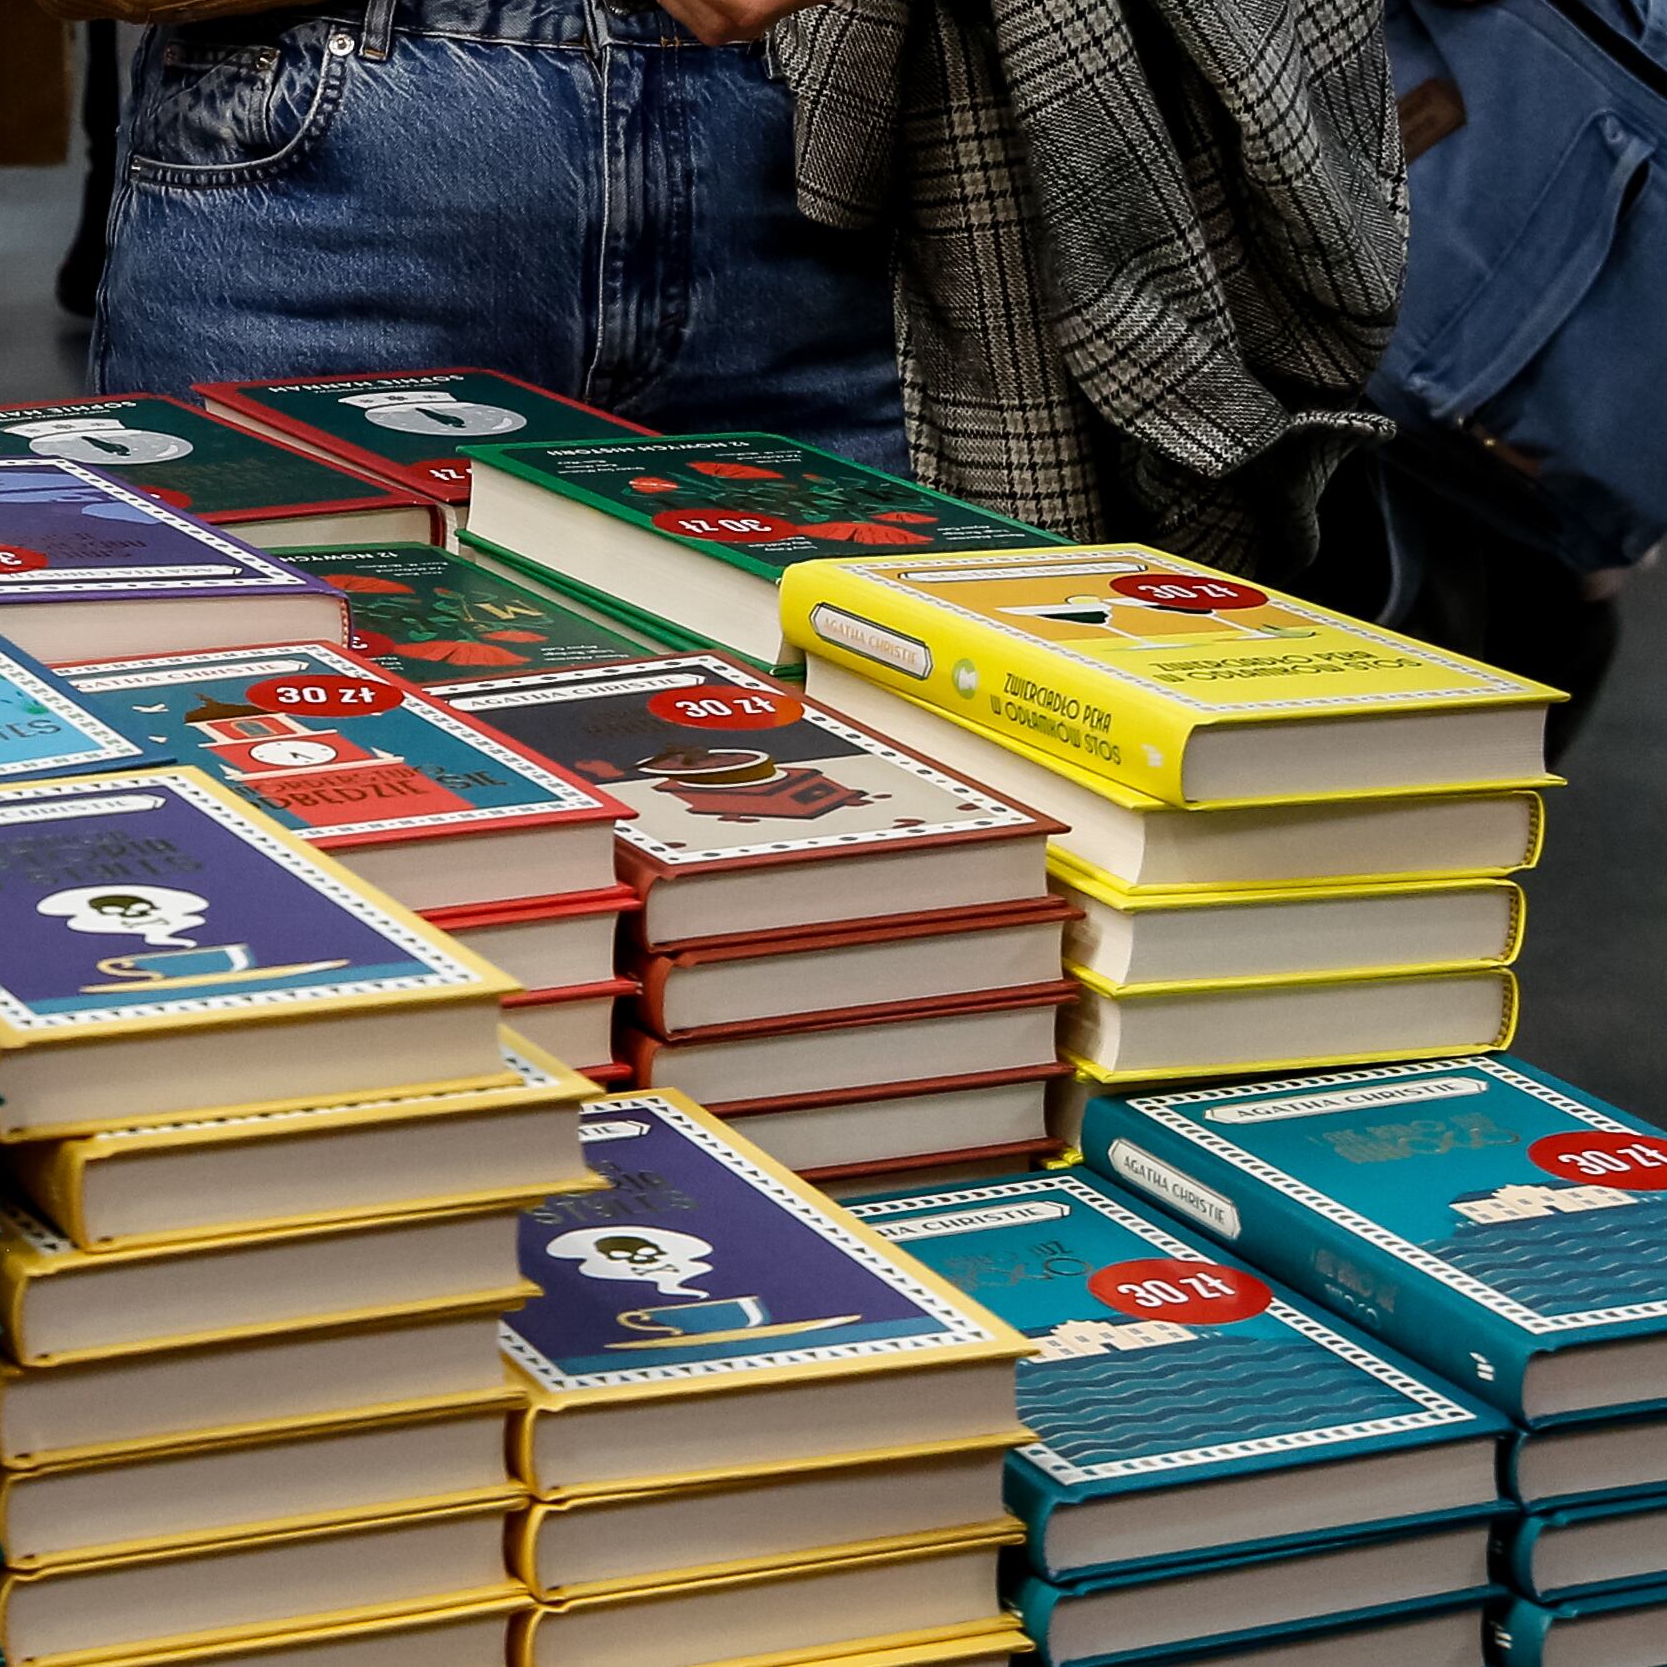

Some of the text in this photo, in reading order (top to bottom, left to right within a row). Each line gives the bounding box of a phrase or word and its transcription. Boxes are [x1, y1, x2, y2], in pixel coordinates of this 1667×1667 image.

[267, 380, 374, 393] HANNAH
[376, 374, 465, 386] SOPHIE
[46, 400, 137, 416] SOPHIE
[637, 441, 728, 453] NOWYCH
[678, 517, 773, 534] 30 zł
[1138, 582, 1241, 600] 30 zł
[821, 615, 920, 669] AGATHA CHRISTIE
[166, 660, 279, 684] CHRISTIE
[1148, 652, 1316, 675] ZWIERCIADŁO
[1352, 656, 1424, 673] STOS
[275, 685, 379, 705] 30 zł
[470, 676, 678, 710] AGATHA CHRISTIE
[1003, 672, 1080, 721] ZWIERCIADŁO
[674, 697, 730, 720] 30
[733, 695, 778, 715] zł
[989, 694, 1003, 715] W
[1083, 729, 1123, 766] STOS
[1235, 1081, 1459, 1122] AGATHA CHRISTIE
[1557, 1150, 1631, 1176] 30
[1121, 1153, 1228, 1227] AGATHA CHRISTIE
[920, 1206, 1041, 1238] CHRISTIE
[1117, 1271, 1237, 1310] 30 zł
